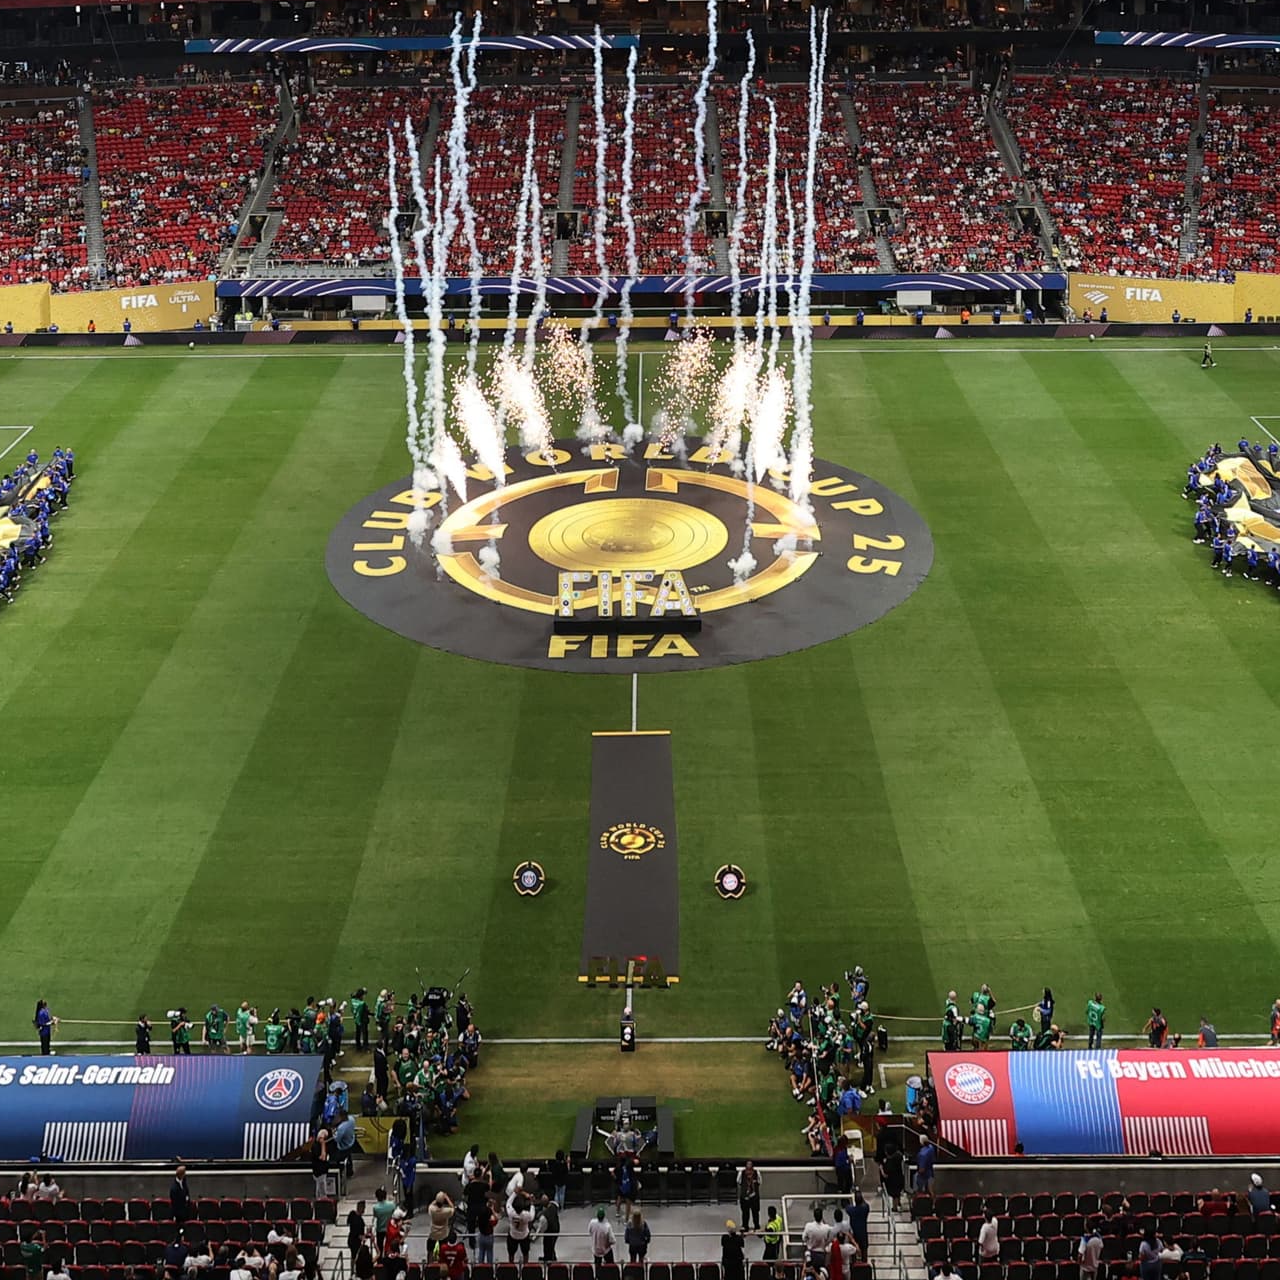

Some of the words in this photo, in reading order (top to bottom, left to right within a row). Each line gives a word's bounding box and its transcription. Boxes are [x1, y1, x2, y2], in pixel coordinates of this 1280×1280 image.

[121, 294, 158, 310] FIFA
[169, 294, 200, 305] ULTRA
[1125, 287, 1162, 302] FIFA
[352, 489, 444, 577] CLUB
[847, 534, 906, 577] 25
[558, 570, 697, 617] FIFA
[547, 633, 700, 658] FIFA
[18, 1063, 175, 1086] Saint-Germain
[265, 1070, 298, 1081] PARIS
[1075, 1059, 1102, 1080] FC
[1109, 1058, 1188, 1082] Bayern
